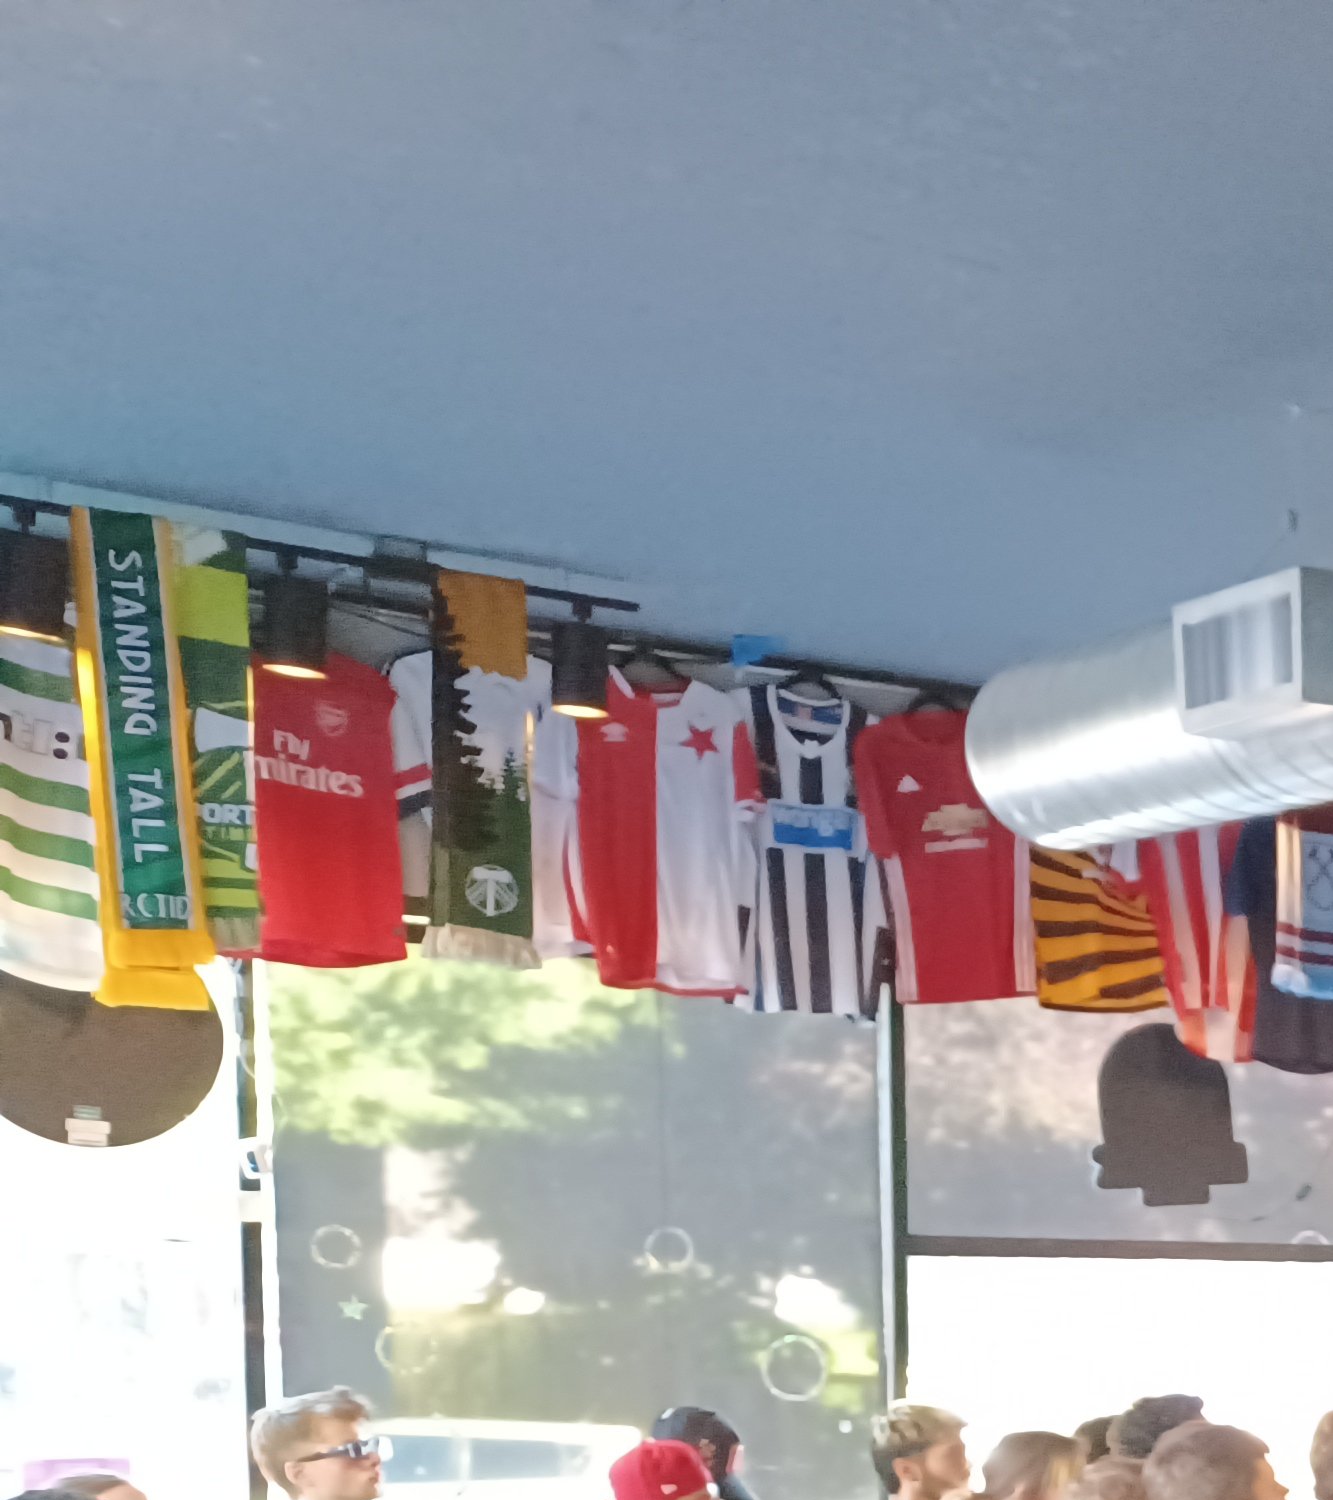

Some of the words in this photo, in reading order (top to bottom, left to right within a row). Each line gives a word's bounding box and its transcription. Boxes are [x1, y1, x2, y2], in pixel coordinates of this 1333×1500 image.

[108, 548, 157, 737] STANDING
[273, 729, 310, 760] Fly
[253, 754, 364, 798] mirates
[127, 766, 169, 864] TALL
[196, 802, 256, 825] ORT
